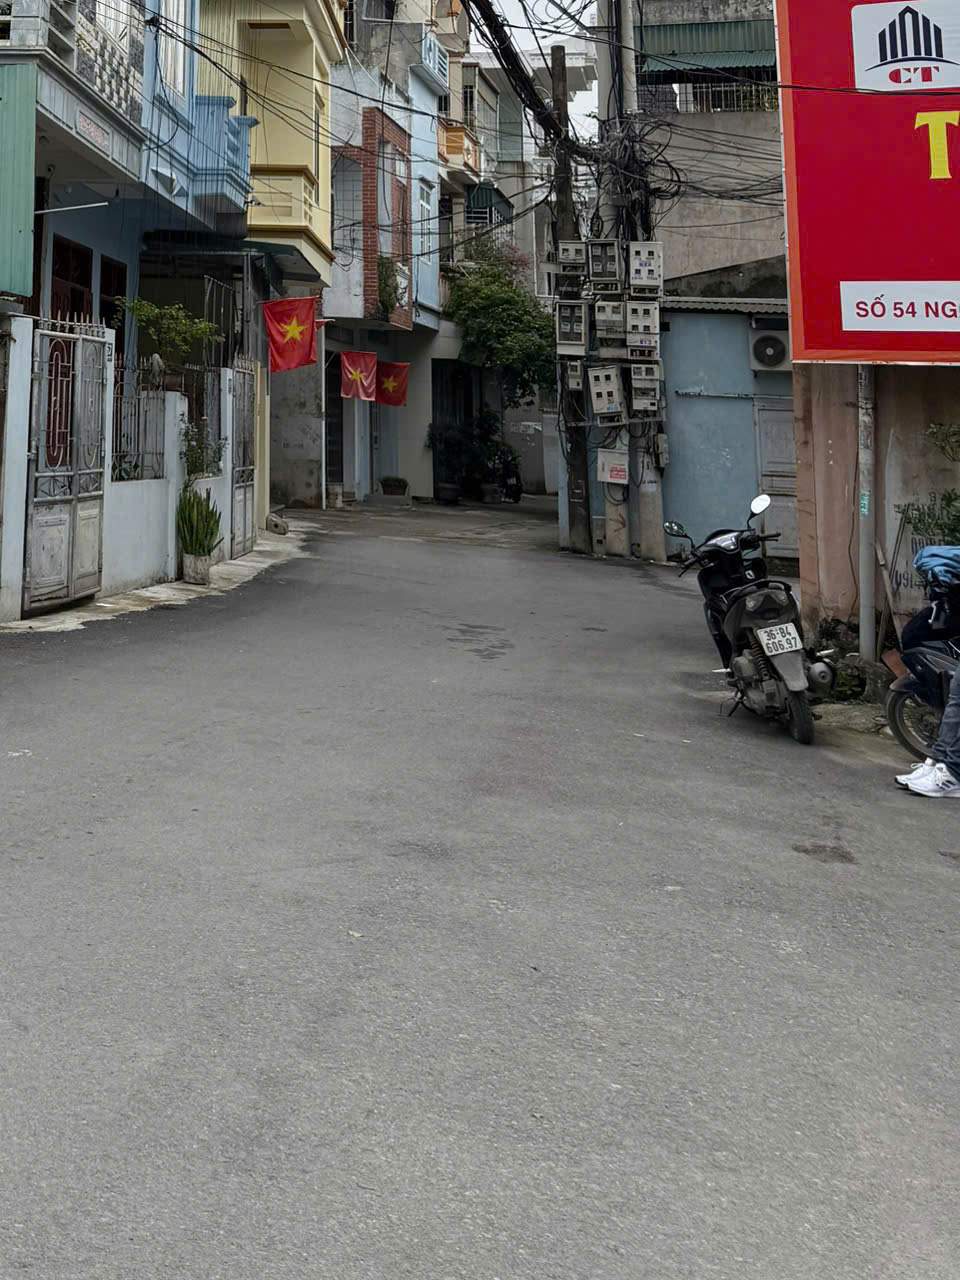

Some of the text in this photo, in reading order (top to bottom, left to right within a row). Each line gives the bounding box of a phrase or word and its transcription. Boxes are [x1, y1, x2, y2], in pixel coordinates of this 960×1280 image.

[888, 66, 939, 84] CT
[855, 294, 960, 318] SỐ 54 NG
[764, 626, 792, 641] 36-B4
[766, 636, 798, 654] 606.97
